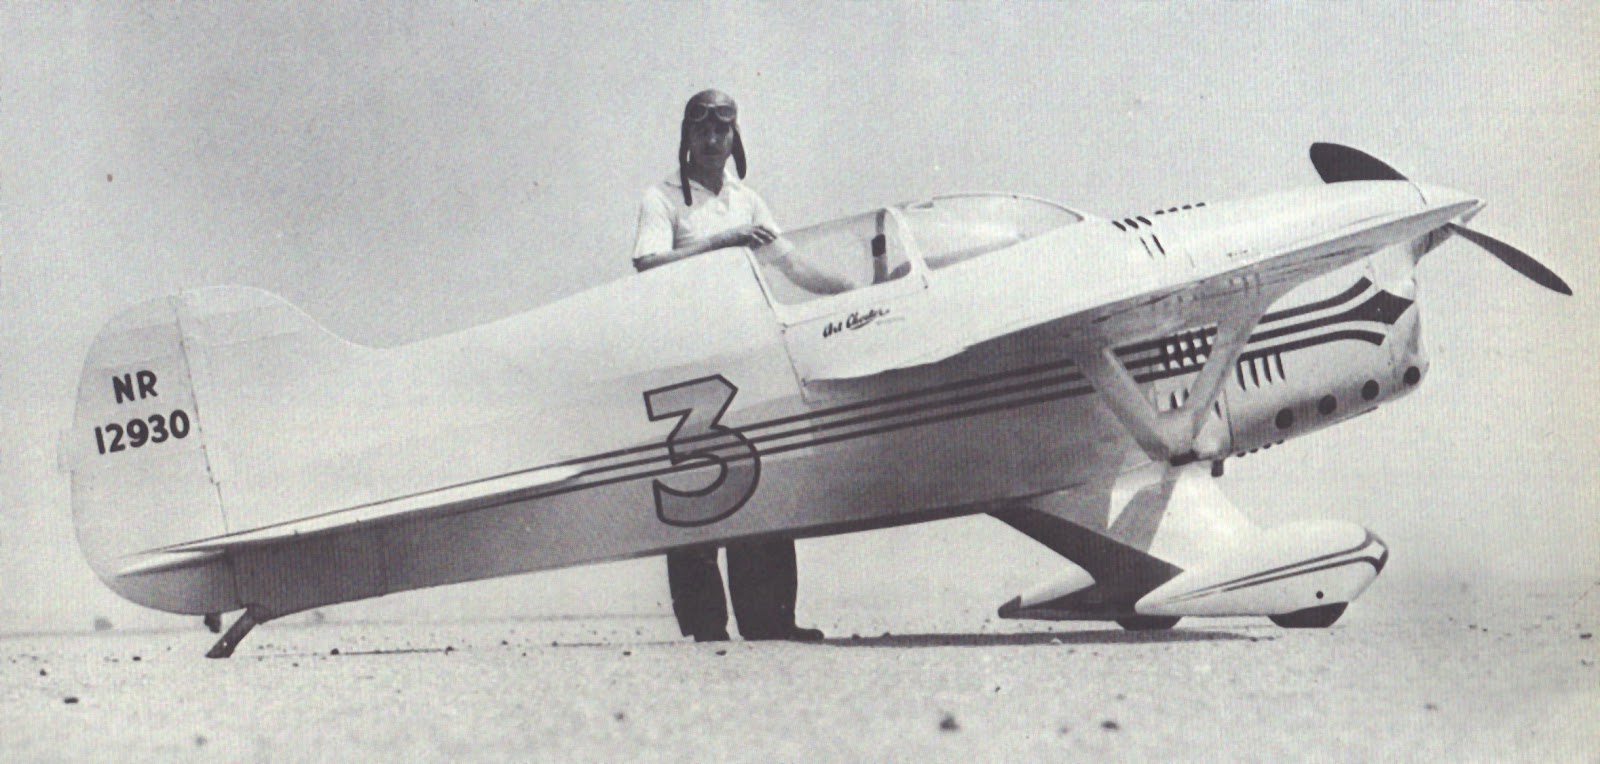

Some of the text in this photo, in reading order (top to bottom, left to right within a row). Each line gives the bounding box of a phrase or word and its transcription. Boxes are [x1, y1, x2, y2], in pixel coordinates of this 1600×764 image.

[112, 370, 158, 404] NR
[94, 409, 190, 455] 12930
[642, 373, 762, 528] 3
